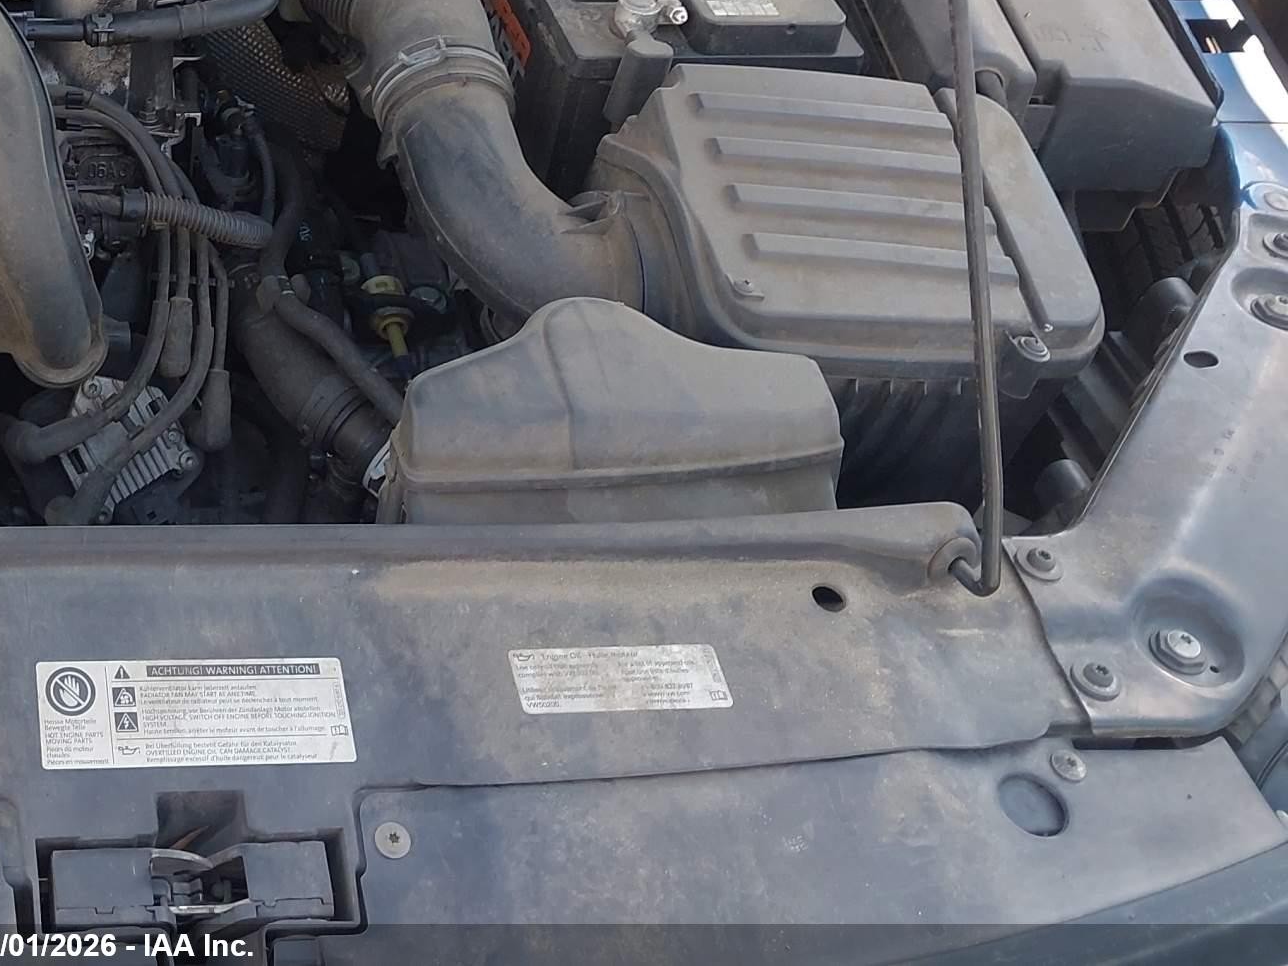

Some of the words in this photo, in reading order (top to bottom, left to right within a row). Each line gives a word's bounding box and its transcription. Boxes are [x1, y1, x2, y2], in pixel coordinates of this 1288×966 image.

[151, 666, 203, 675] ACHTUNG!
[206, 665, 257, 674] WARNING!
[260, 665, 317, 674] ATTENTION!
